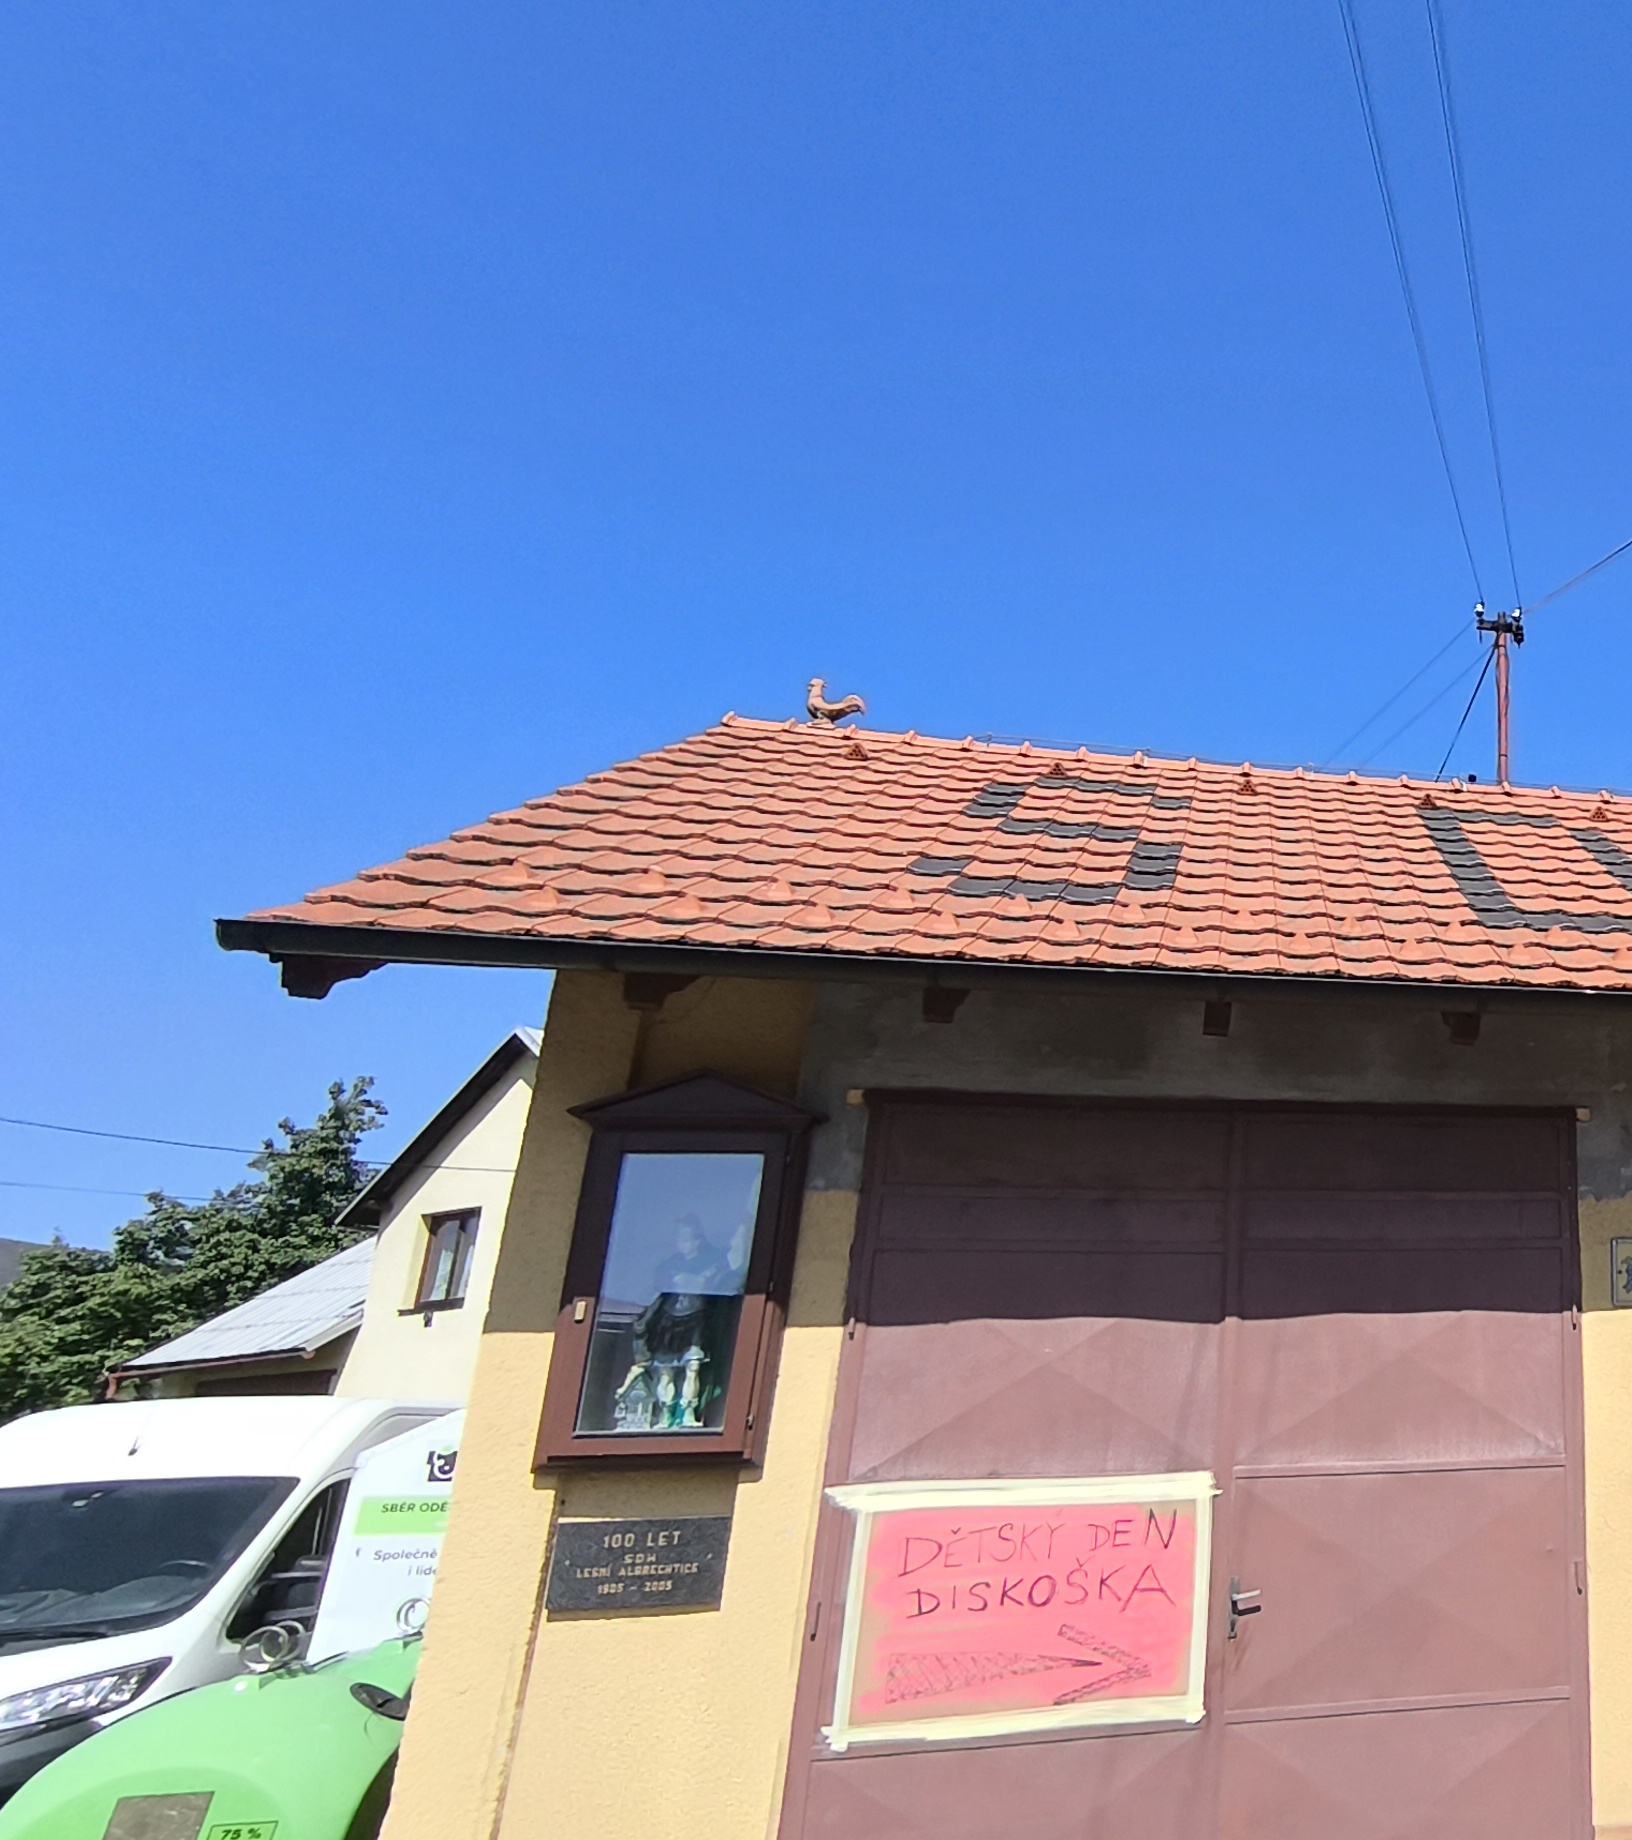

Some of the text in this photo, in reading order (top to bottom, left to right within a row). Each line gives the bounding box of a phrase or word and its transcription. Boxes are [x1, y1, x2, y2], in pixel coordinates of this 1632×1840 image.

[603, 1530, 682, 1549] 100 LET
[898, 1507, 1178, 1578] DĚTSKÝ DEN
[618, 1562, 699, 1577] ALBRECHTICE
[644, 1580, 673, 1592] 2005
[906, 1557, 1177, 1620] DISKOŠKA
